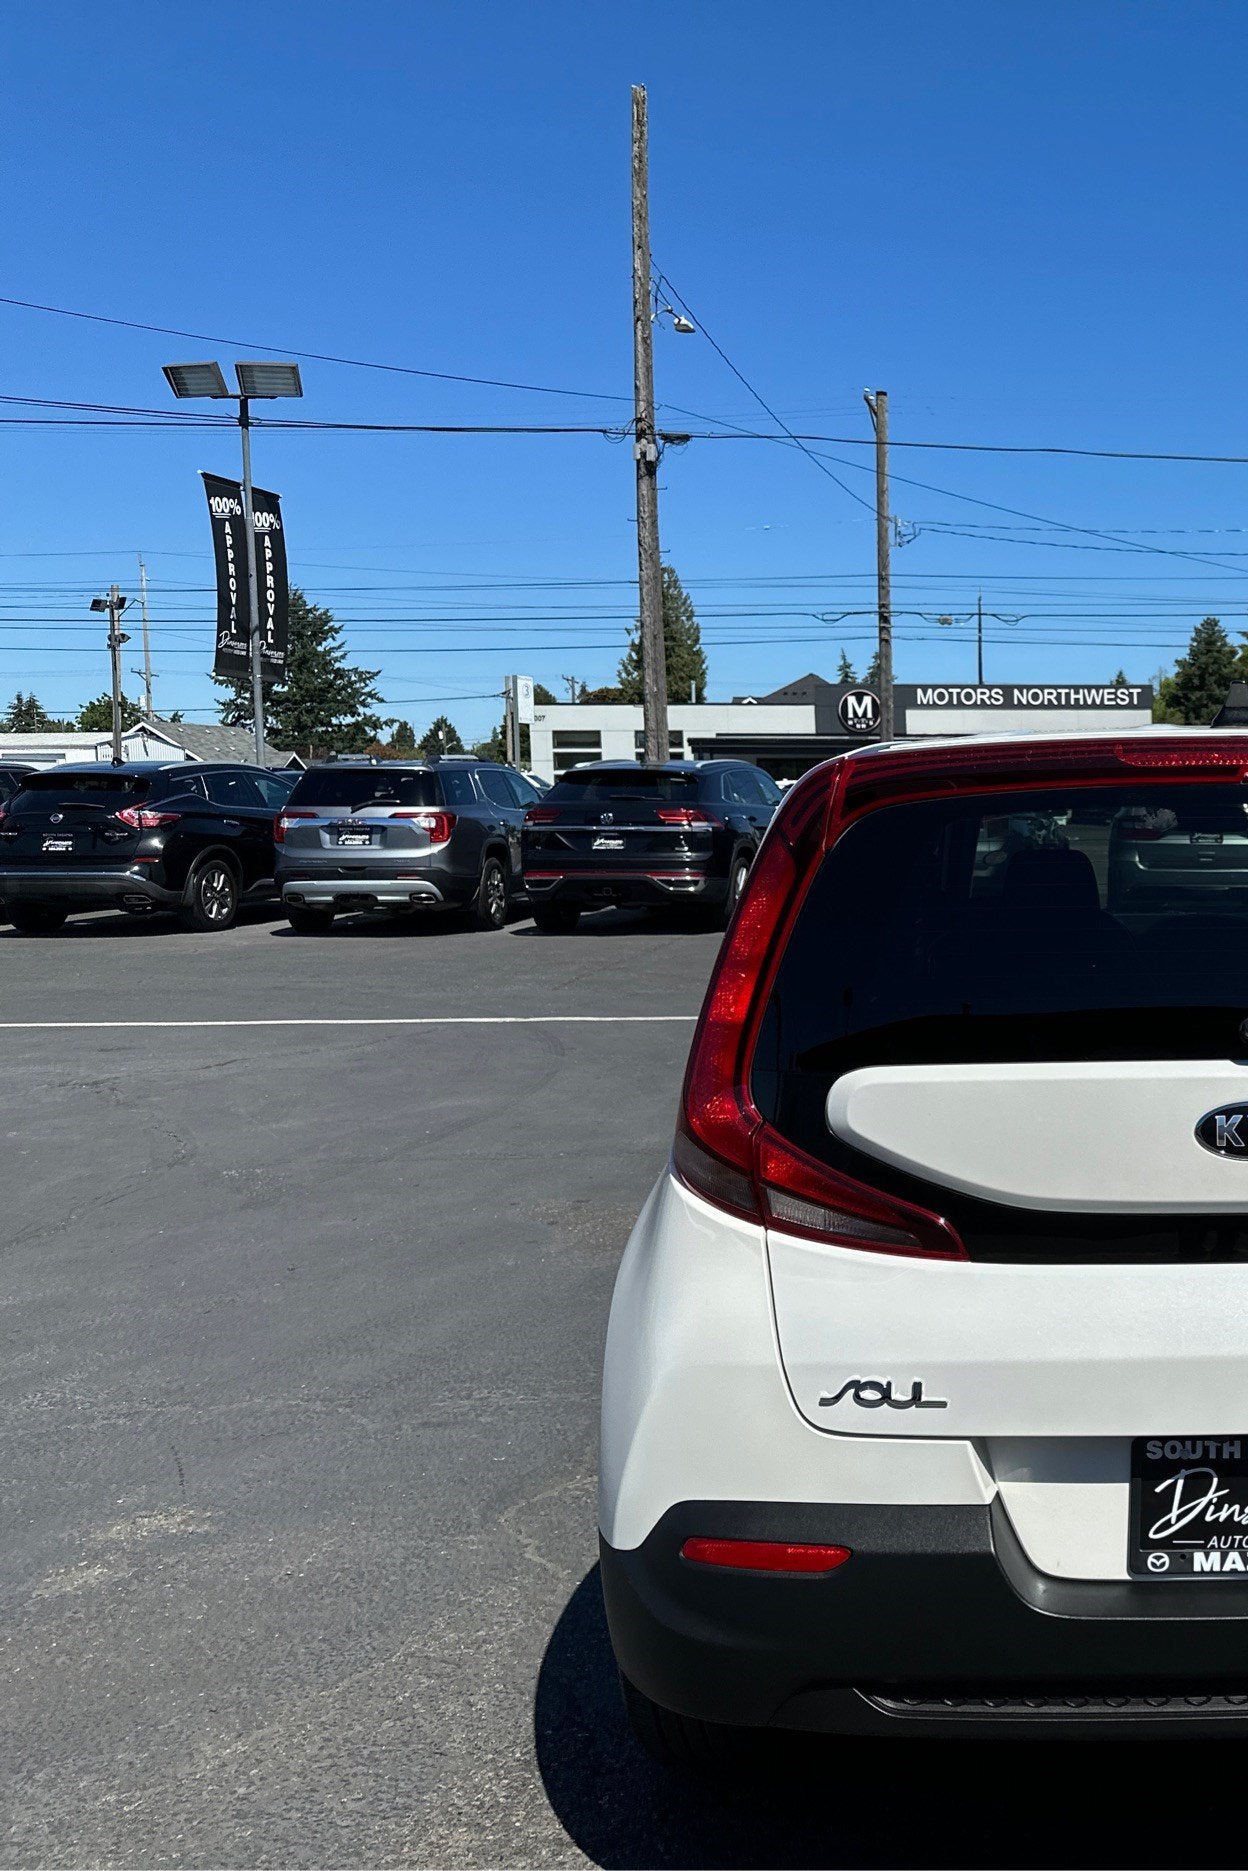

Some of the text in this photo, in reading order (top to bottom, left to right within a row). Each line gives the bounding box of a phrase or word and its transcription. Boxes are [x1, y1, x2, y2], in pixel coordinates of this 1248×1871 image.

[209, 496, 242, 516] 100%
[224, 521, 237, 634] APPROVAL
[264, 534, 276, 643] APPROVAL
[847, 695, 873, 719] M
[916, 688, 1142, 705] MOTORS NORTHWEST
[818, 1379, 948, 1410] SOUL
[1146, 1440, 1241, 1460] SOUTH
